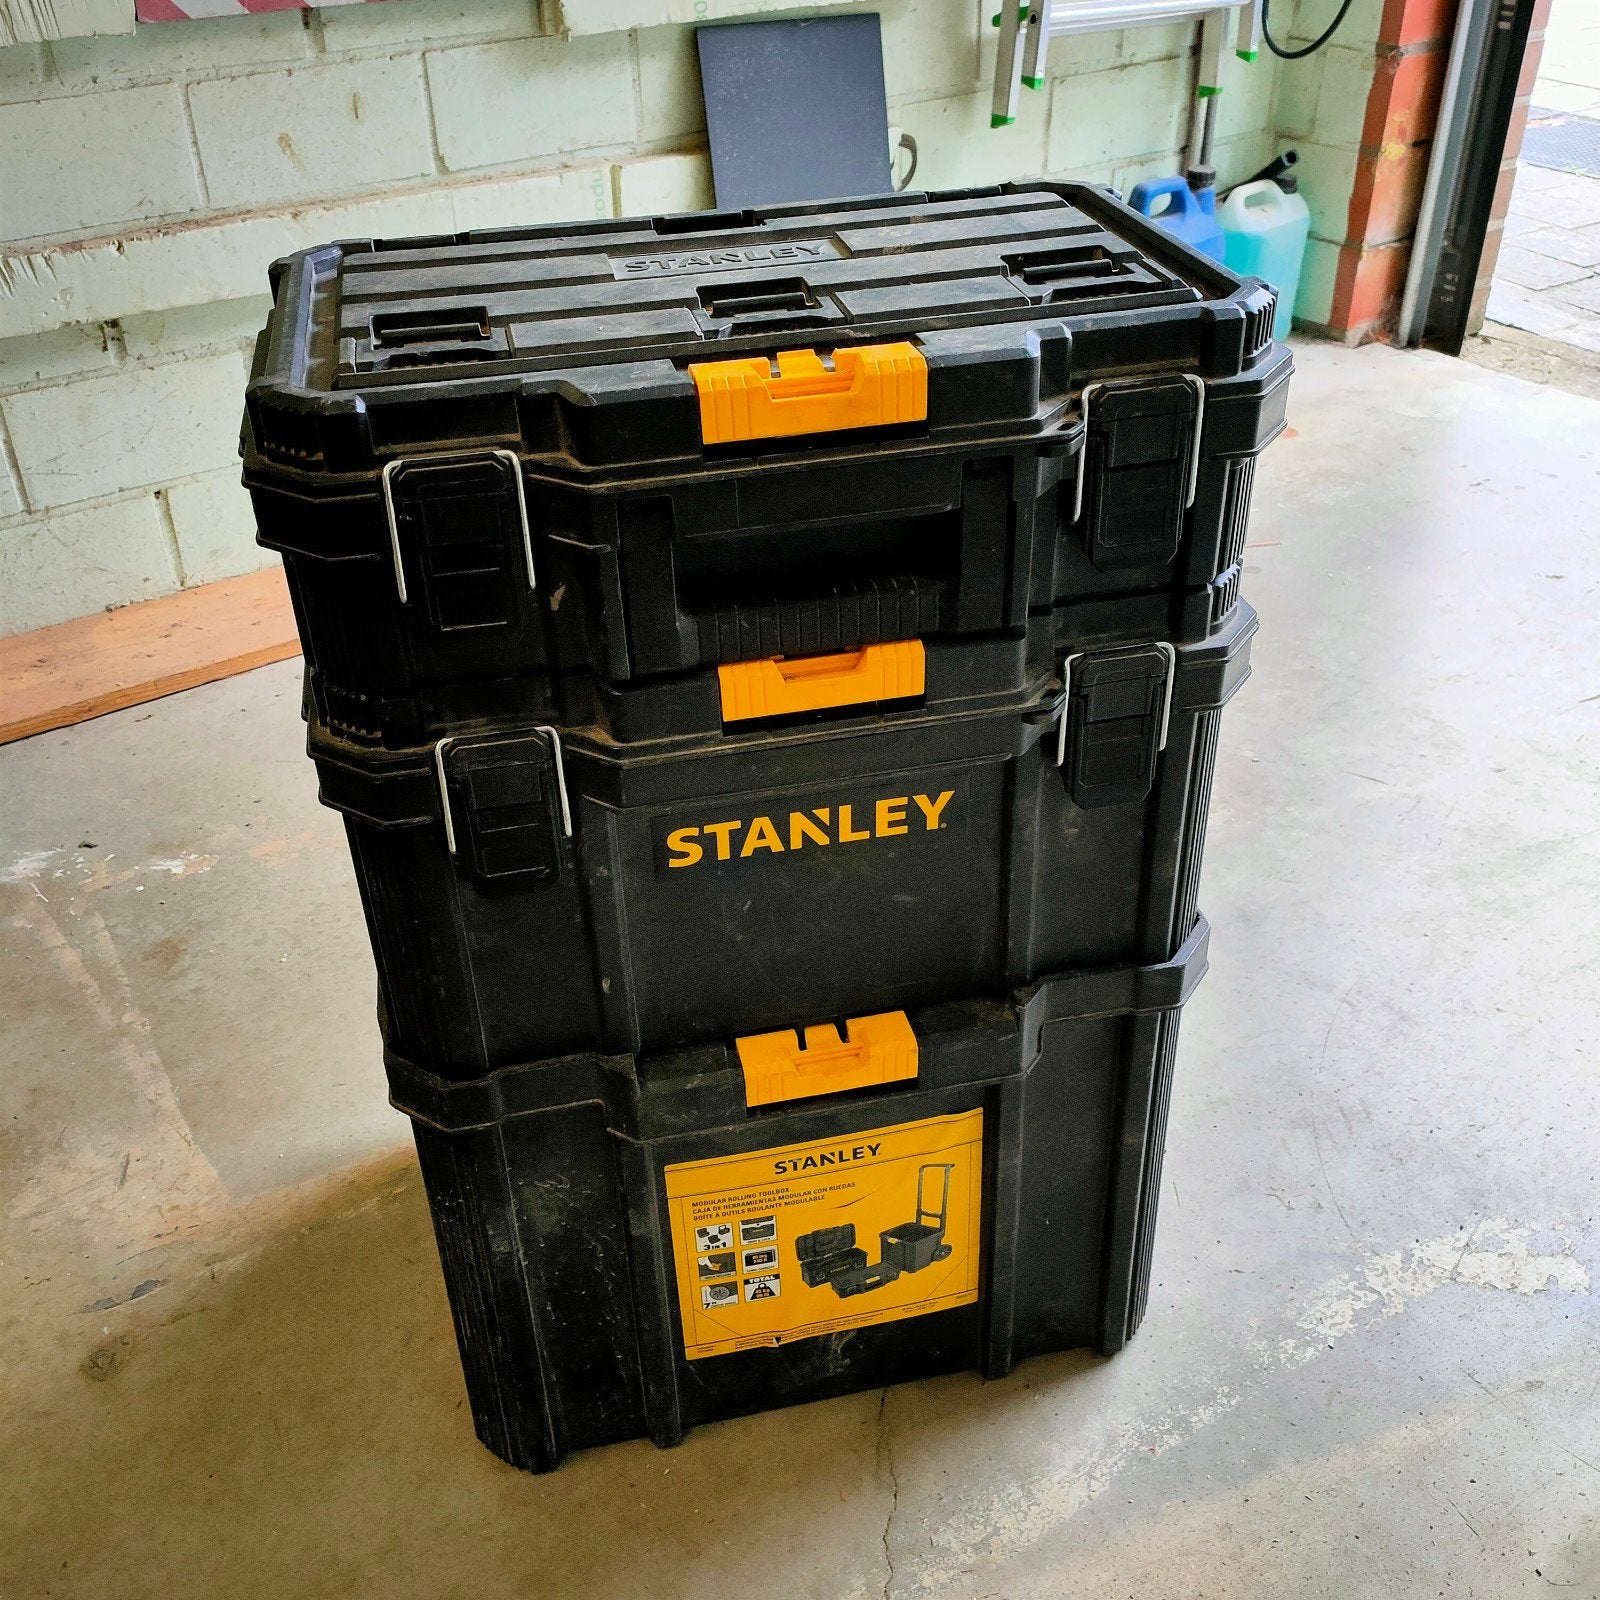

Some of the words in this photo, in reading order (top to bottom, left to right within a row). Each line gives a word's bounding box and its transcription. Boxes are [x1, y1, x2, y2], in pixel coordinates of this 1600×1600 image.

[624, 243, 824, 273] STANLEY
[666, 790, 955, 868] STANLEY
[774, 1143, 881, 1175] STANLEY
[691, 1198, 726, 1208] MODULAR
[728, 1193, 757, 1203] ROLLING
[758, 1187, 790, 1198] TOOLBOX
[692, 1206, 711, 1215] CAJA
[712, 1204, 722, 1212] DE
[723, 1196, 778, 1210] HERRAMIENTAS
[778, 1190, 812, 1201] MODULAR
[828, 1181, 857, 1192] RUEDAS
[721, 1208, 746, 1218] OUTILS
[747, 1202, 783, 1213] ROULANTE
[784, 1194, 826, 1206] MODULABLE
[749, 1275, 776, 1284] TOTAL
